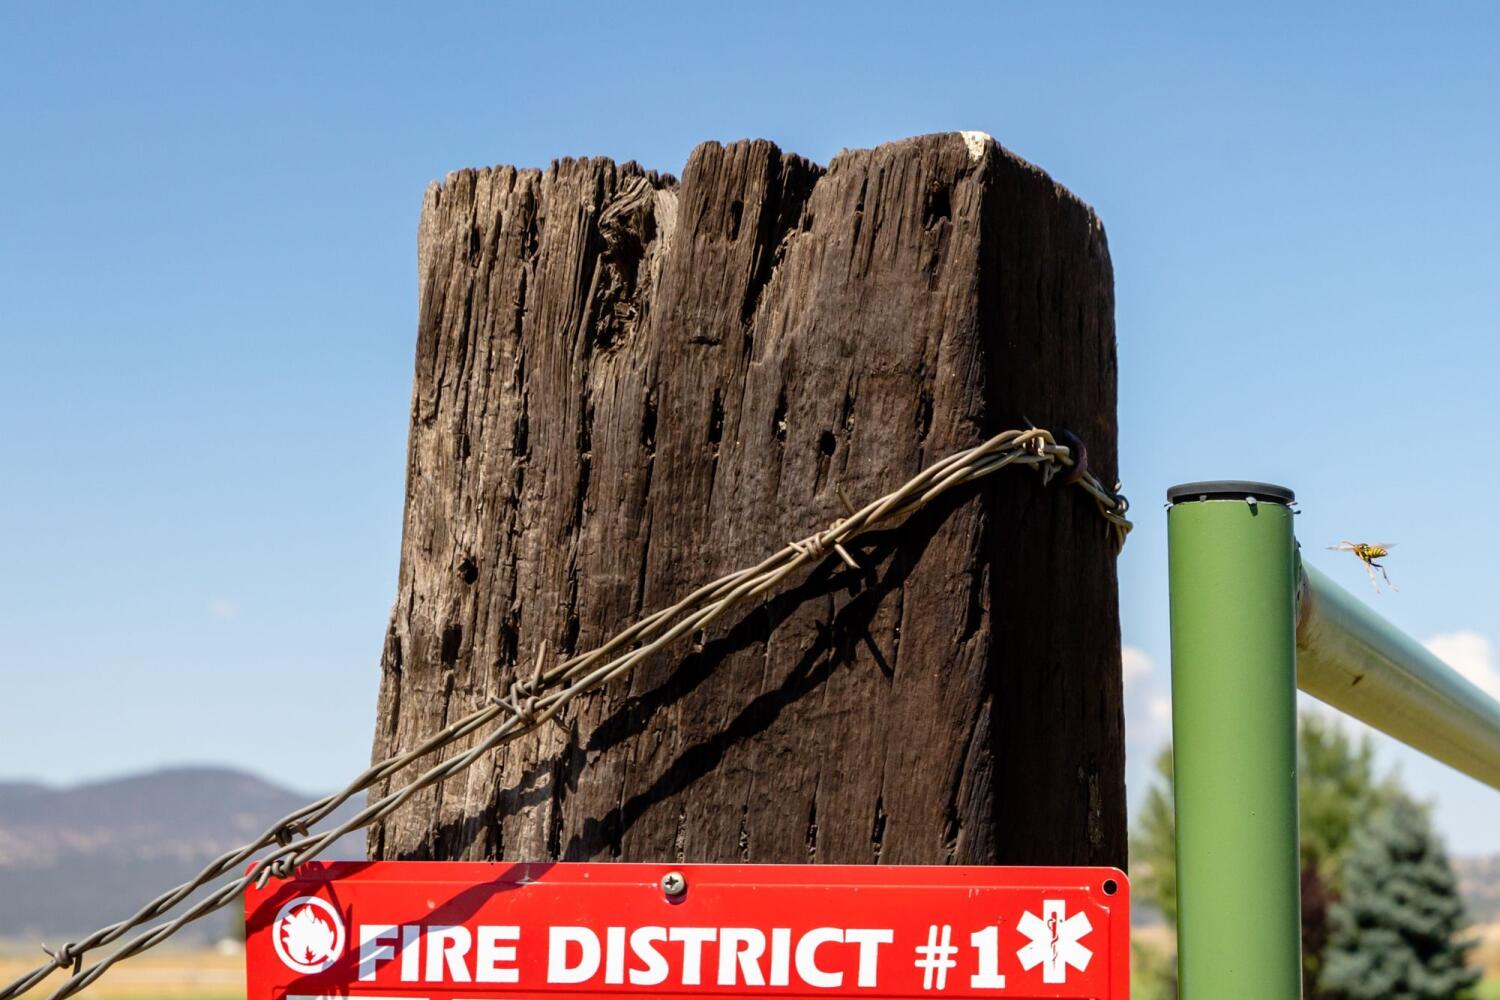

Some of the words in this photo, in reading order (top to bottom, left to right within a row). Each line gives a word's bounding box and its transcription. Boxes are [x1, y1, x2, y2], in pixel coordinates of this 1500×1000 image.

[359, 925, 521, 983] FIRE
[547, 926, 893, 987] DISTRICT
[914, 925, 1006, 990] #1
